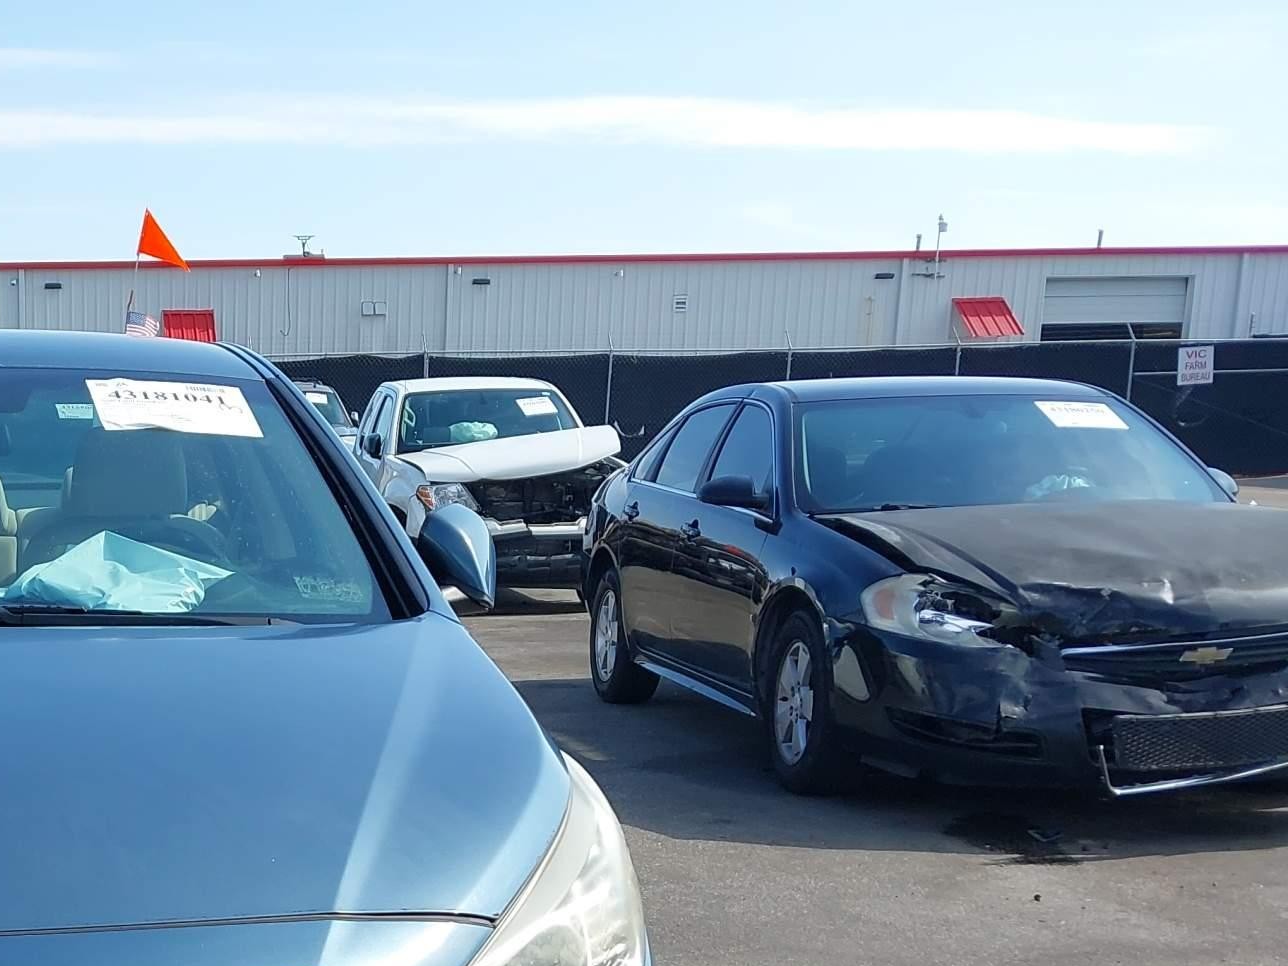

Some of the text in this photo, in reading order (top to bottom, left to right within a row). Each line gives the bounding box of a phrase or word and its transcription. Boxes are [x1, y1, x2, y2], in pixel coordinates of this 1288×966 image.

[1186, 349, 1207, 358] VIC
[1185, 360, 1206, 370] FARM
[1181, 371, 1210, 381] BUREAU
[108, 390, 225, 405] 43181041
